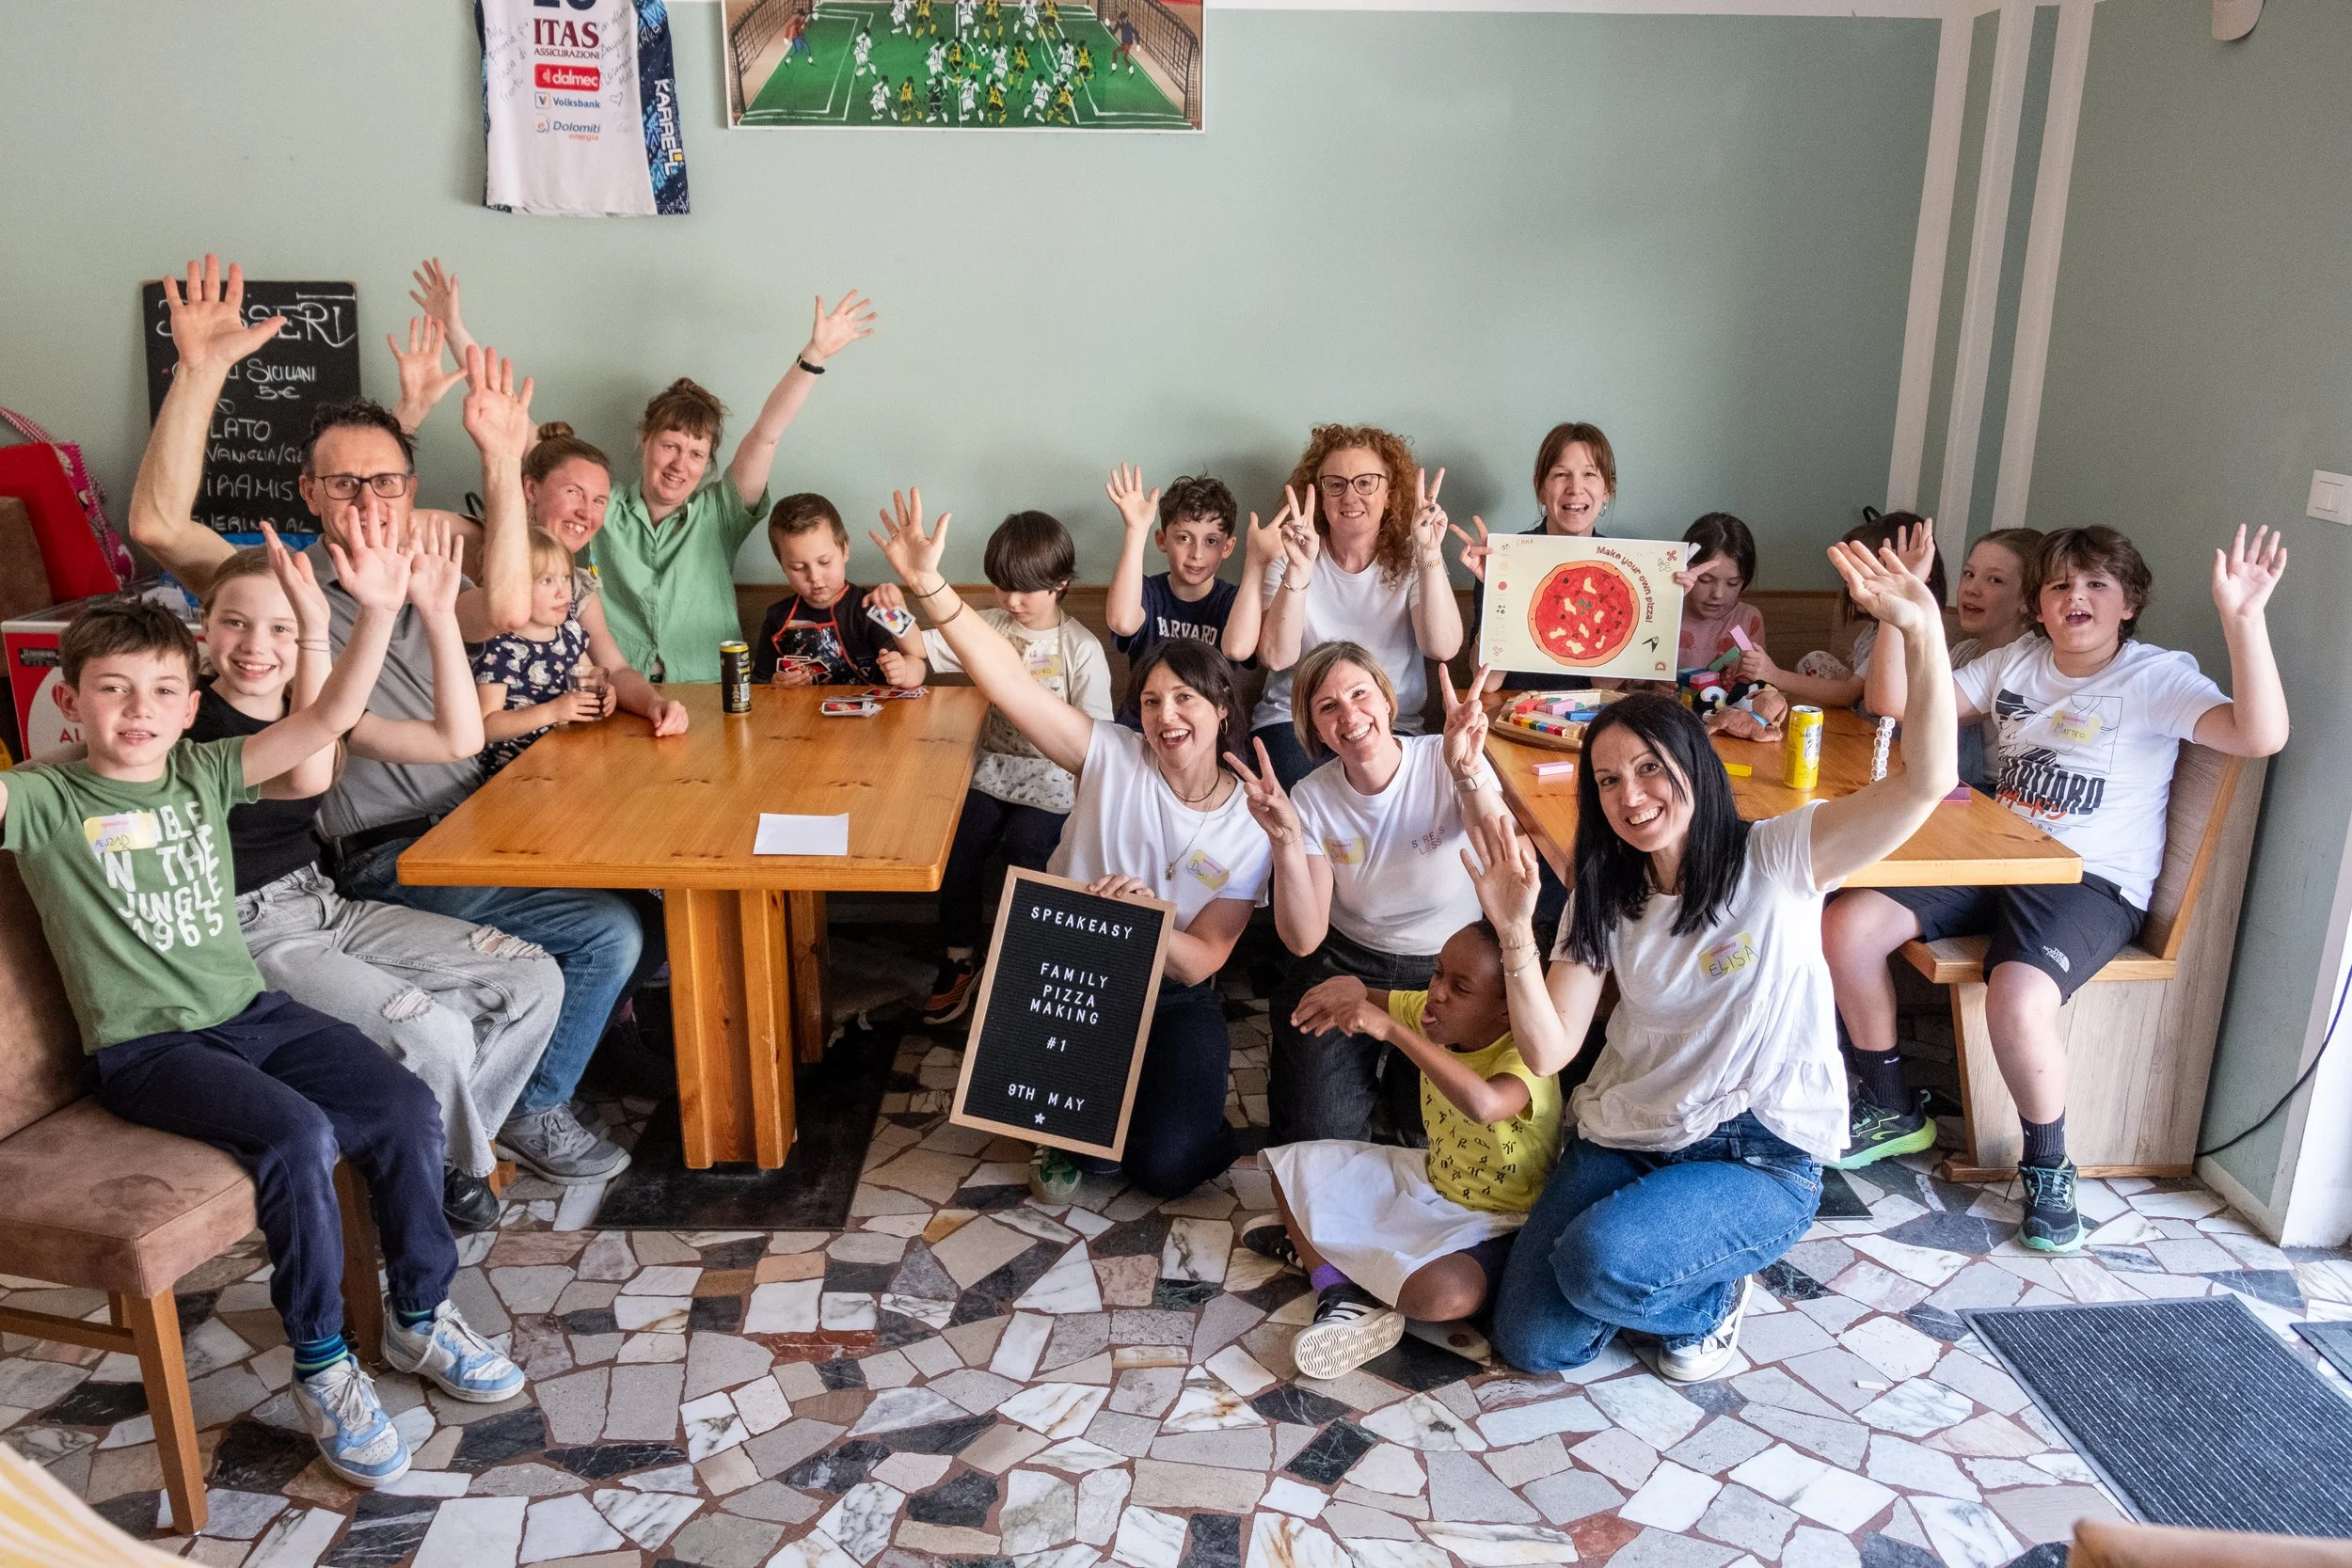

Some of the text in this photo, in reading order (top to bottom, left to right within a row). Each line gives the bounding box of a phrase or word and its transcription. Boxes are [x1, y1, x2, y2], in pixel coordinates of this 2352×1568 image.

[533, 18, 599, 49] ITAS
[533, 48, 600, 59] ASSICURAZIONI
[552, 69, 598, 87] dalmec
[552, 97, 601, 109] Volksbank
[552, 120, 601, 134] Dolomiti
[209, 418, 271, 441] LATO
[1596, 546, 1621, 560] Make
[1620, 556, 1642, 575] your
[1638, 575, 1652, 595] own
[1645, 596, 1655, 625] pizza!
[1157, 616, 1218, 646] HARVARD
[131, 898, 224, 953] 1965
[1031, 906, 1134, 941] SPEAKEASY
[1708, 944, 1759, 976] ELISA
[1041, 962, 1108, 990] FAMILY
[1042, 985, 1096, 1008] PIZZA
[1029, 998, 1100, 1025] MAKING
[1008, 1084, 1085, 1112] 9TH MAY
